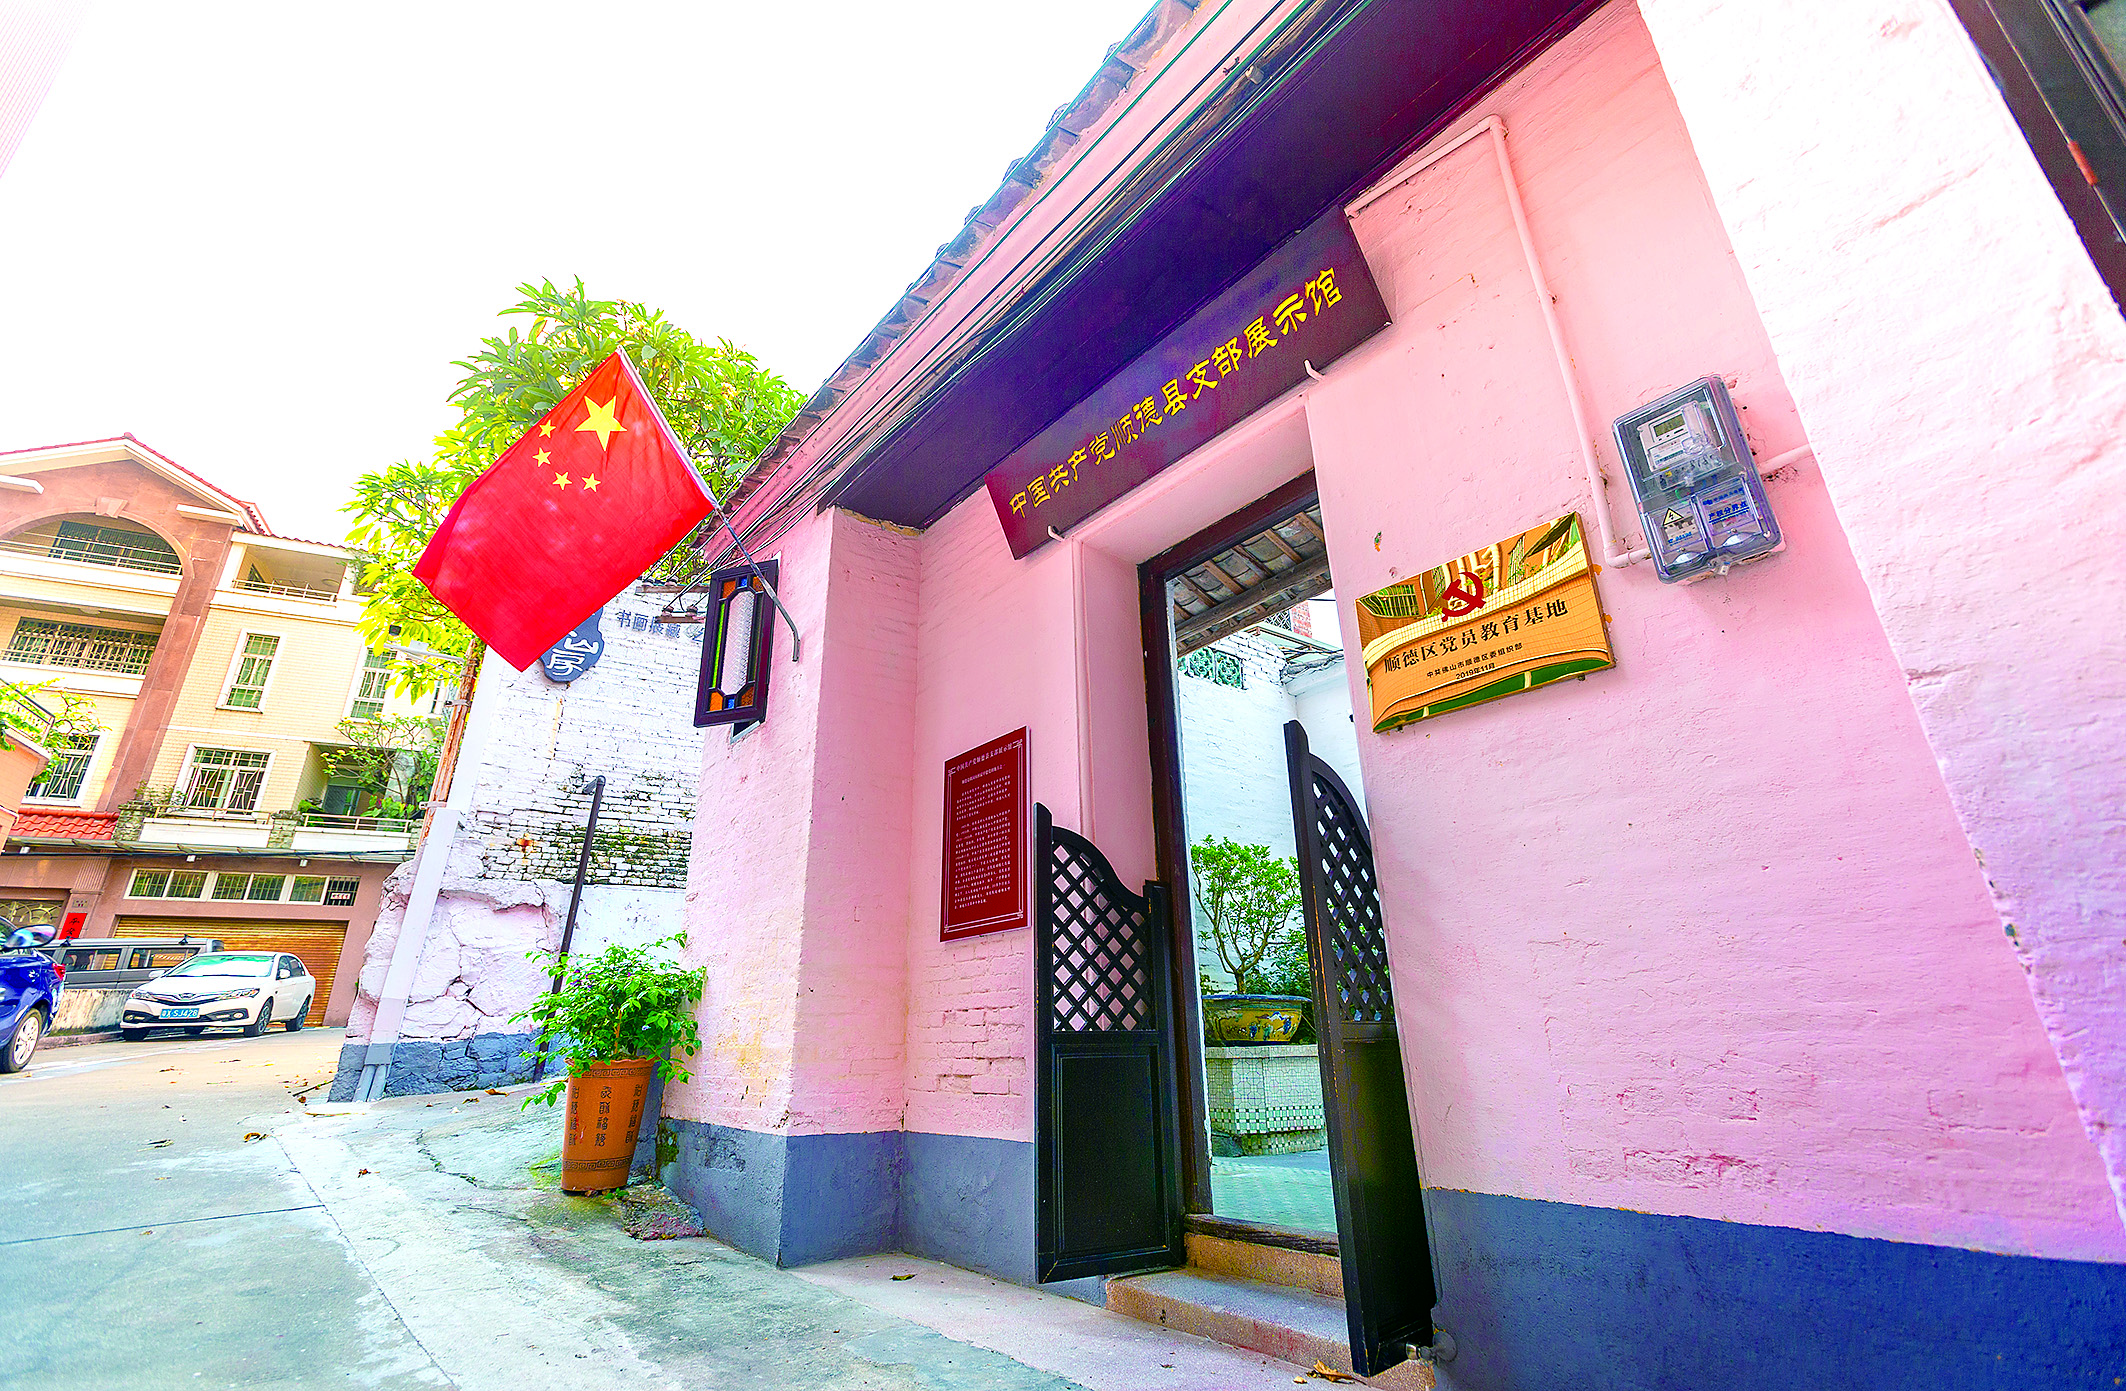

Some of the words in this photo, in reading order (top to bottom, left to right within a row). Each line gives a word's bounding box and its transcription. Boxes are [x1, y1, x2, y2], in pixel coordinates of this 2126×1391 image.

[1009, 267, 1343, 519] 中国共产党顺德县支部展示馆
[1385, 599, 1569, 674] 顺德区党员教育基地
[1427, 642, 1523, 678] 中共佛山市顺德区委组织部
[1456, 662, 1495, 680] 2019年11月
